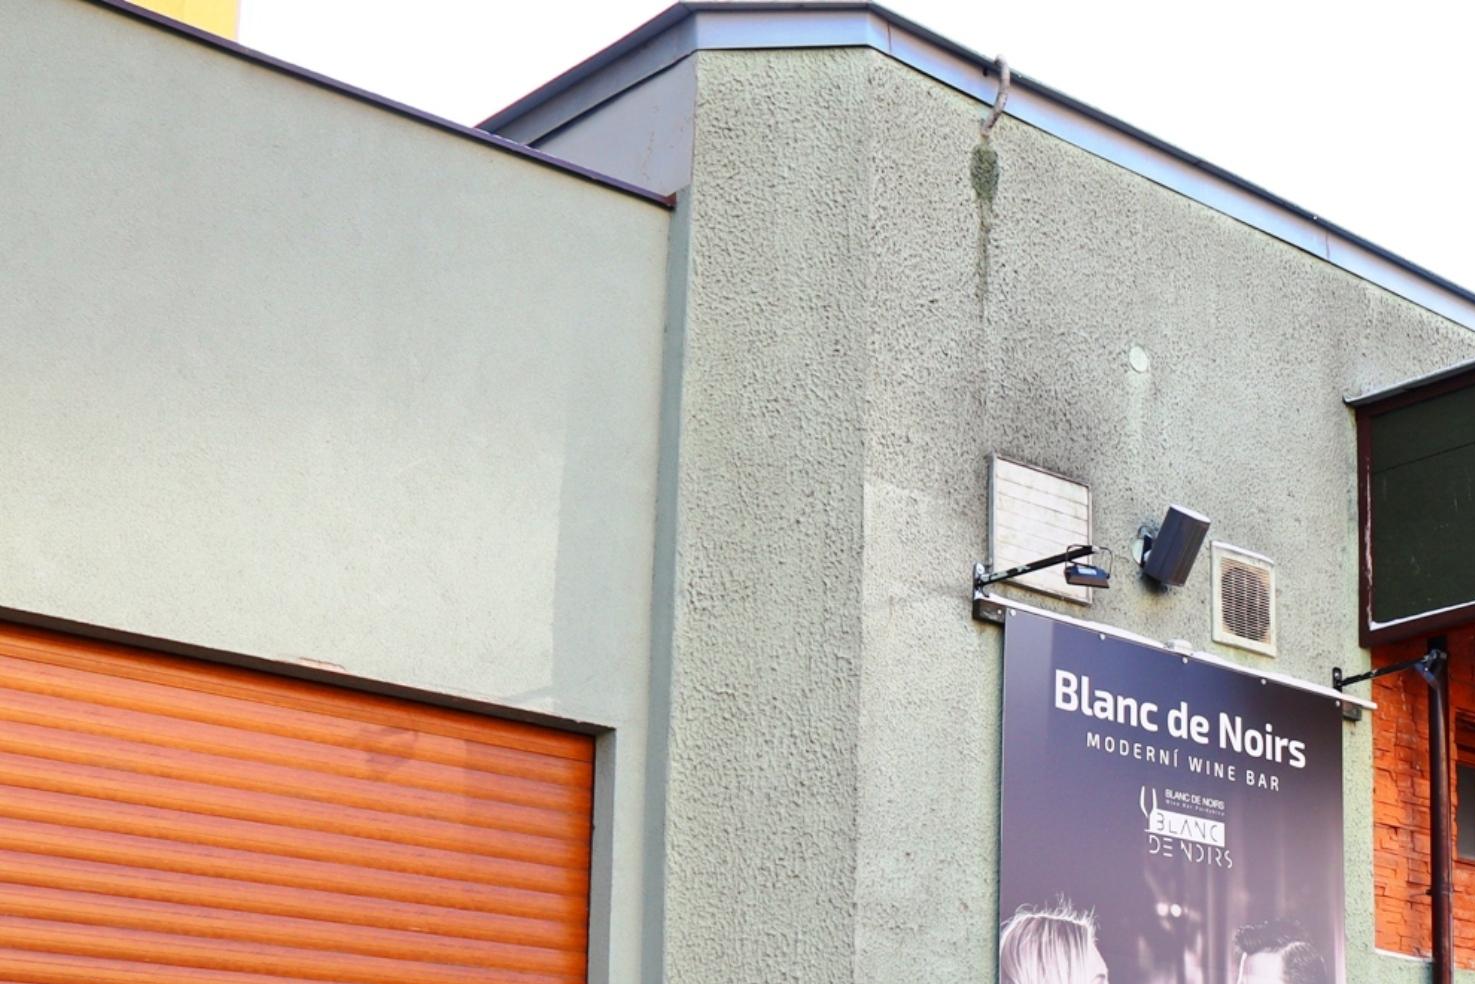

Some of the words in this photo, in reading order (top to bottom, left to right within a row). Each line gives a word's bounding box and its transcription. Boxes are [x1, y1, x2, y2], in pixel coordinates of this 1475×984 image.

[1054, 668, 1159, 733] Blanc
[1167, 701, 1209, 745] de
[1219, 712, 1307, 769] Noirs
[1086, 731, 1180, 769] MODERNÍ
[1188, 755, 1237, 782] WINE
[1245, 770, 1280, 793] BAR
[1164, 788, 1190, 802] BLANC
[1191, 794, 1201, 805] DE
[1202, 797, 1225, 811] NOIRS
[1156, 812, 1219, 843] BLANC
[1149, 834, 1173, 858] DE
[1180, 840, 1233, 869] NOIRS
